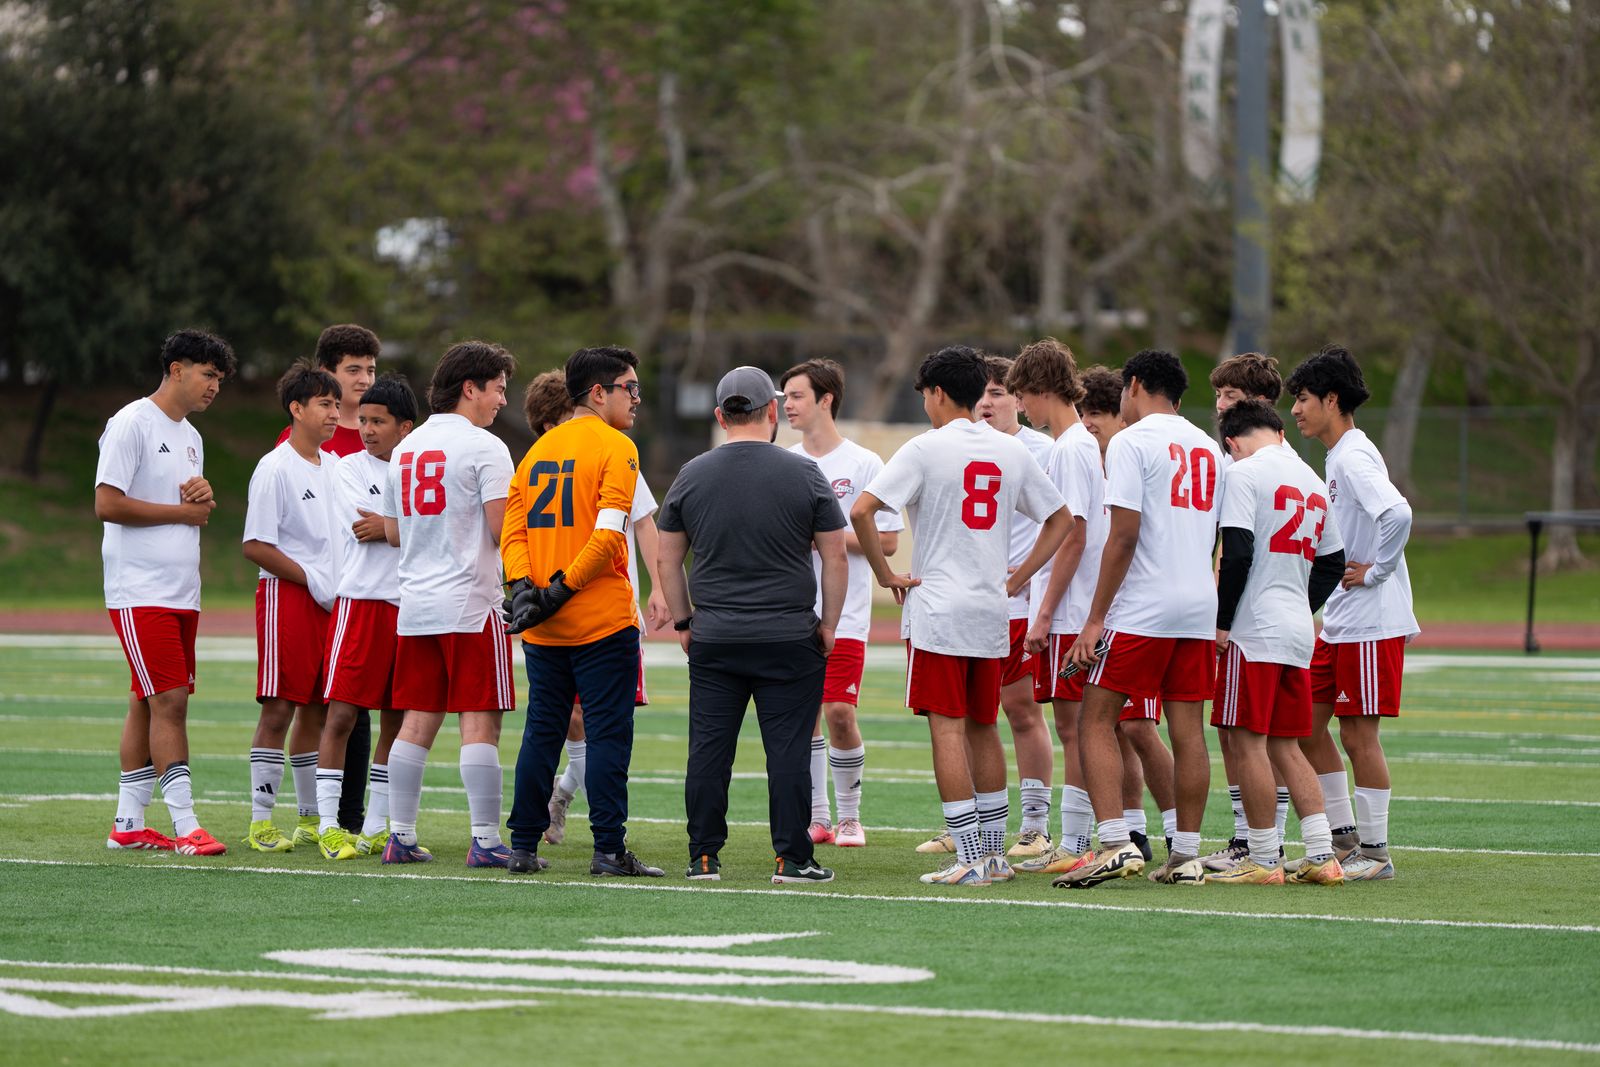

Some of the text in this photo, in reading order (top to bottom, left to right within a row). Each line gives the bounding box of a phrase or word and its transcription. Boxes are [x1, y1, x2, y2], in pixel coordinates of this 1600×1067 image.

[400, 449, 447, 517] 18
[527, 459, 575, 529] 21
[961, 460, 1003, 531] 8
[1169, 443, 1217, 512] 20
[1270, 484, 1328, 563] 23
